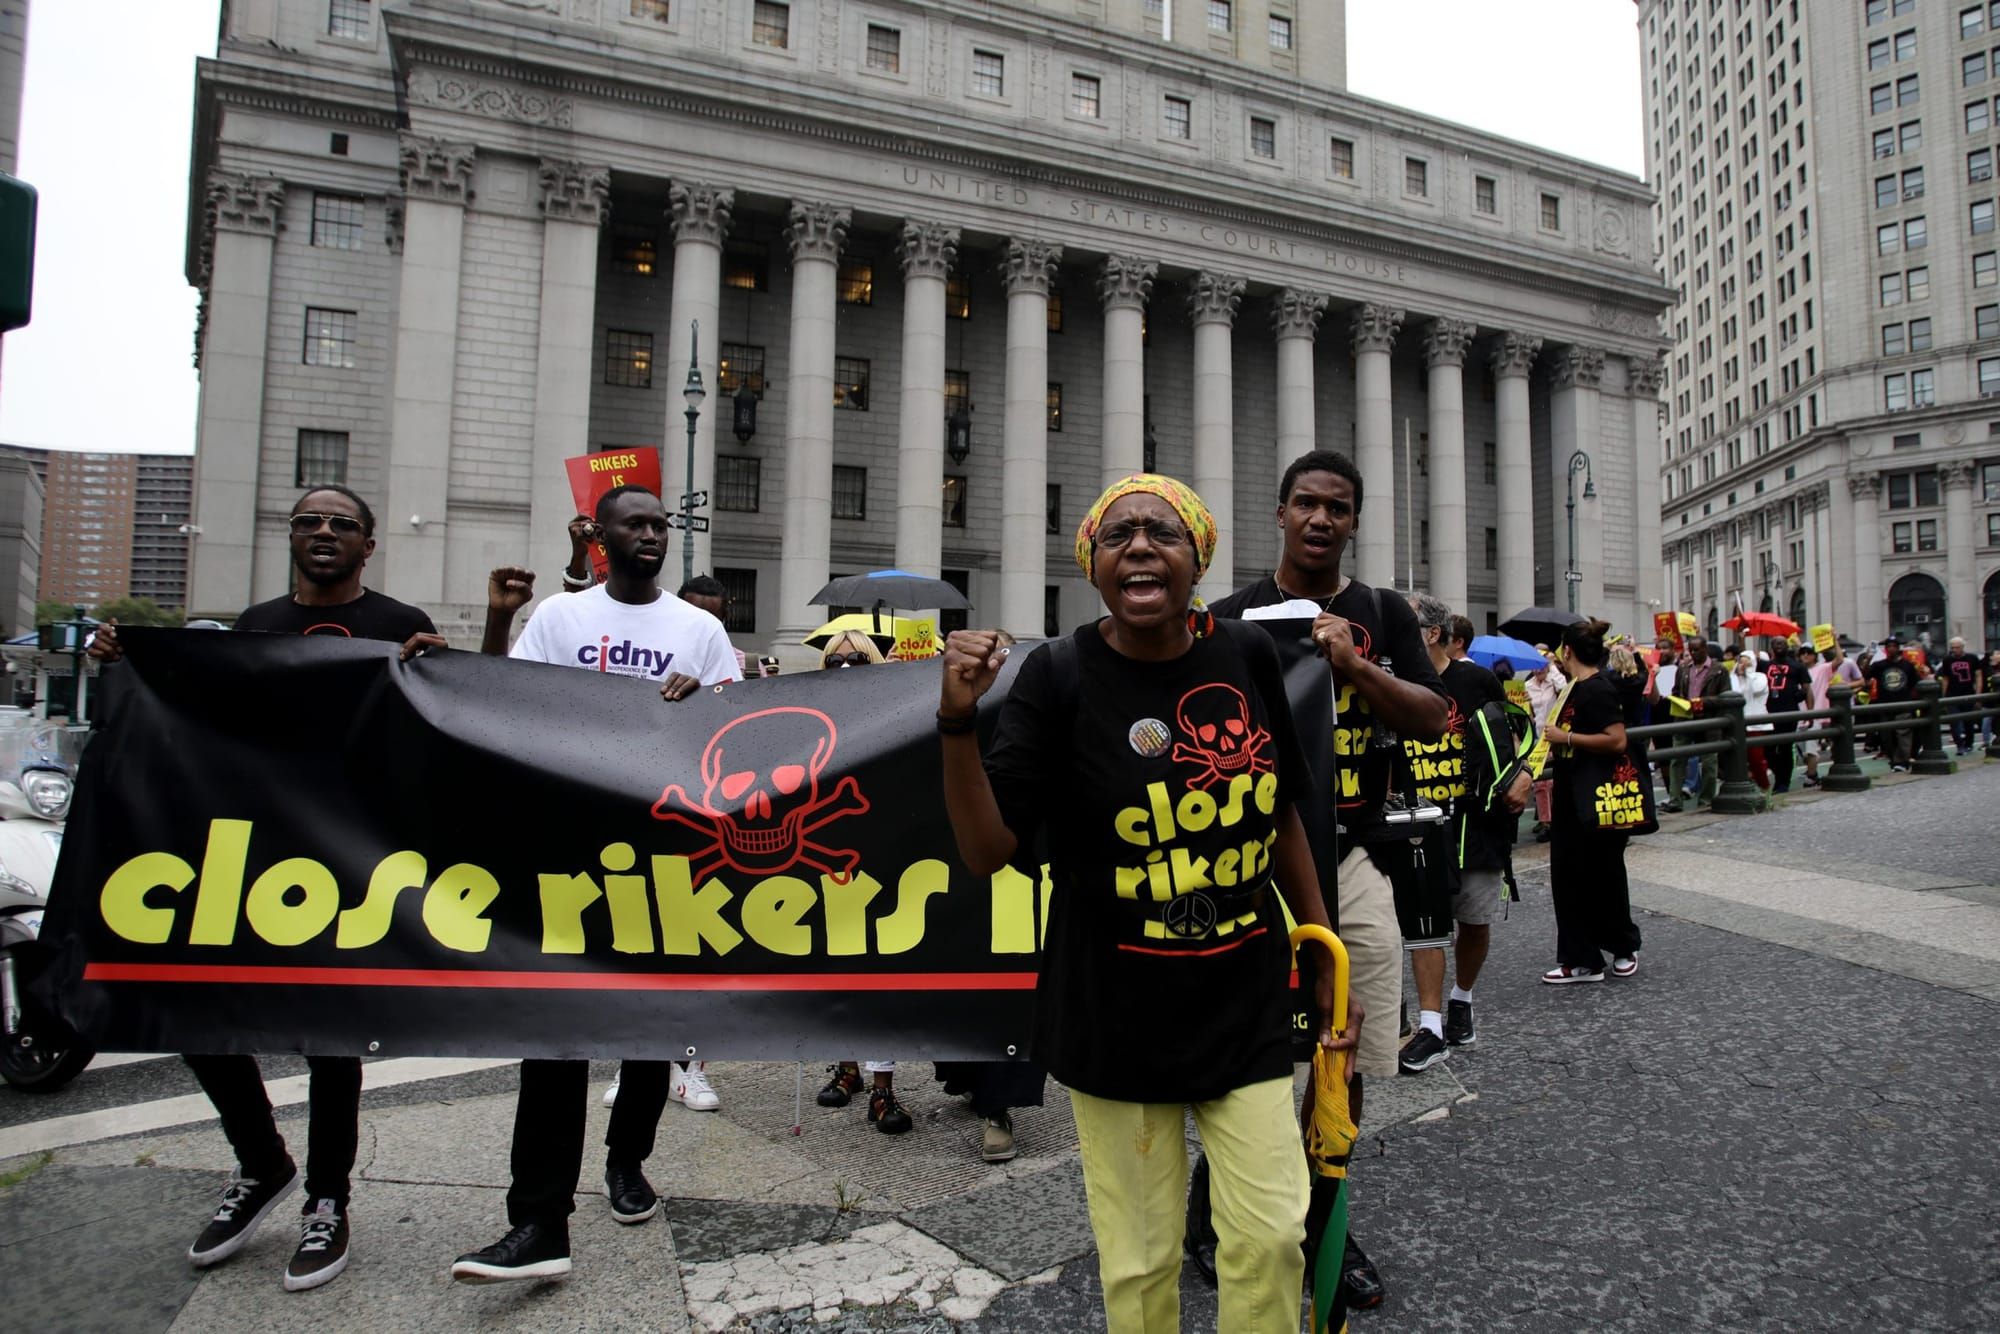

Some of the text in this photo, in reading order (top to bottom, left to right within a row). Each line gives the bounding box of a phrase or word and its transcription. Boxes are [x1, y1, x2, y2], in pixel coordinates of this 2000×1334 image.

[903, 167, 1406, 282] UNITED STATES COURT HOUSE
[589, 453, 638, 473] RIKERS
[611, 474, 625, 489] IS
[577, 634, 675, 677] cidny
[900, 638, 934, 650] close
[1595, 781, 1640, 798] close
[1595, 794, 1643, 812] rikers
[1114, 772, 1278, 847] close
[1115, 828, 1278, 901] rikers
[100, 817, 501, 953] close
[537, 842, 949, 956] rikers
